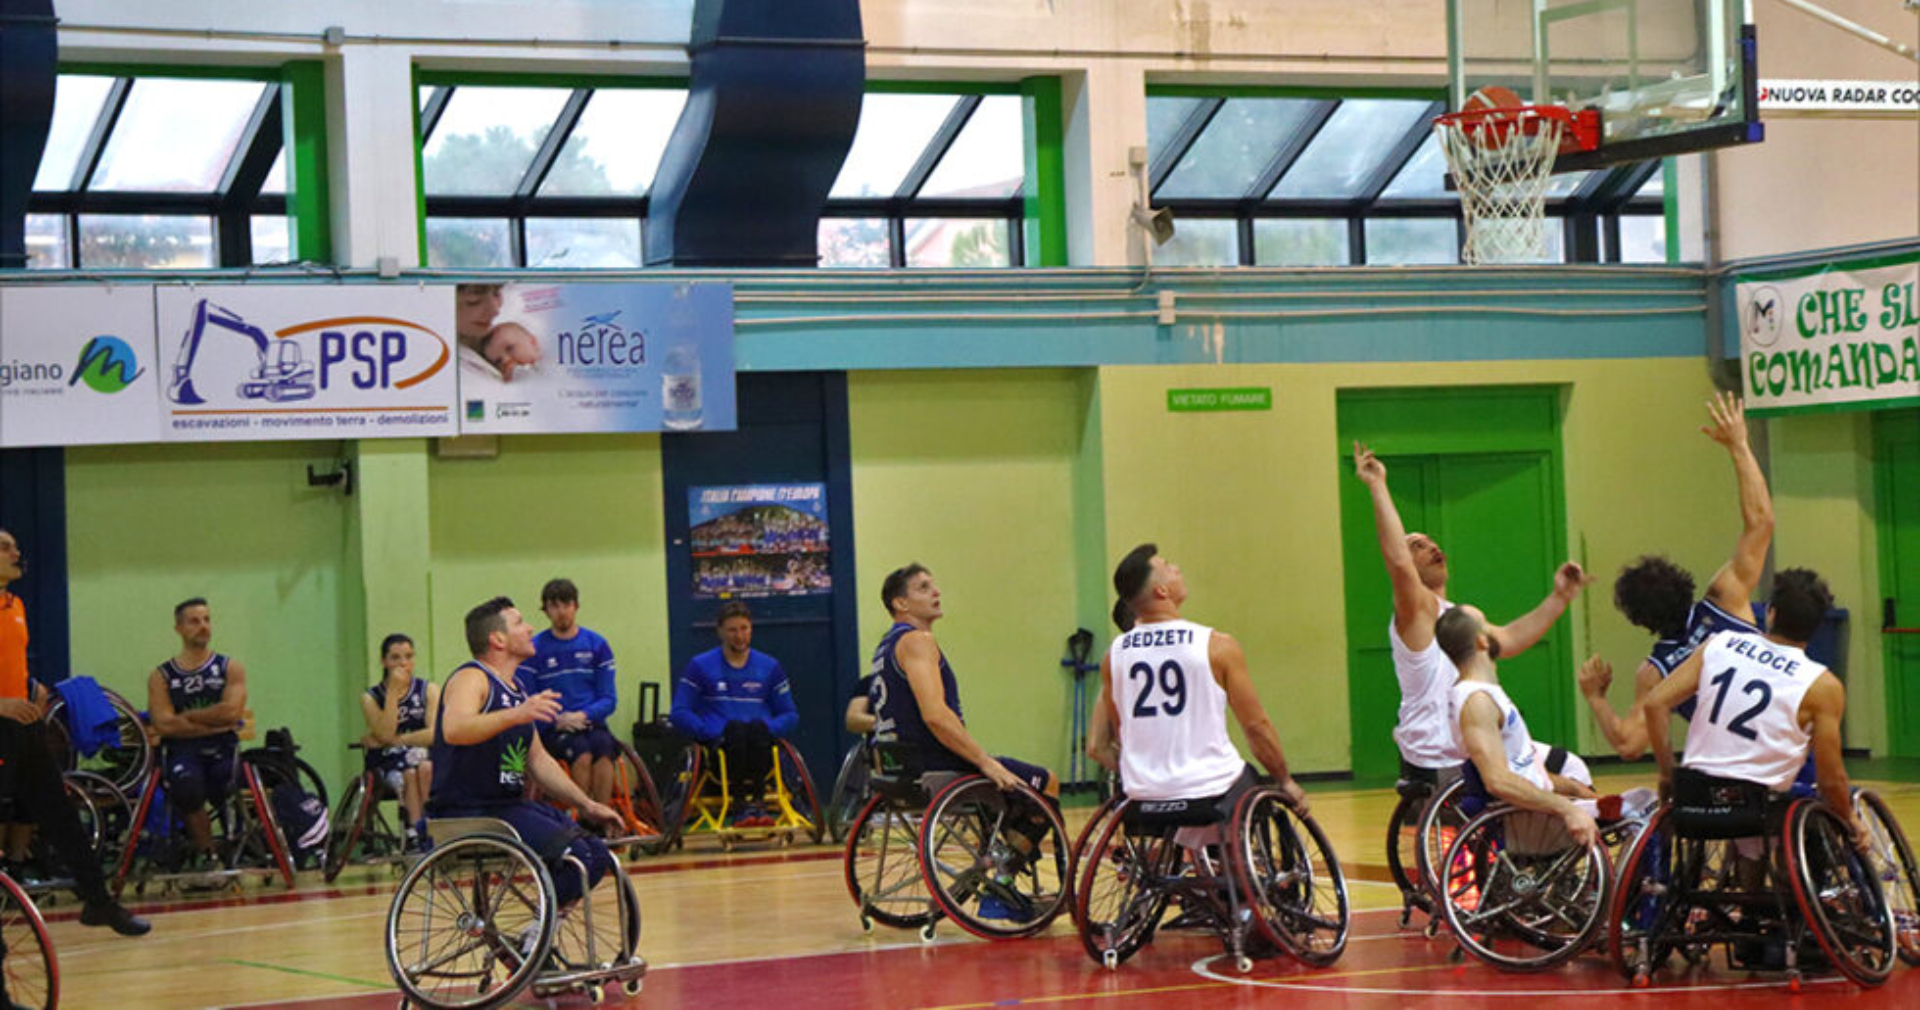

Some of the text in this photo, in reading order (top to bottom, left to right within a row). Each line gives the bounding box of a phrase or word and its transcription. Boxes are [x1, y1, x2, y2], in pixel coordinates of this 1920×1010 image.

[1768, 86, 1827, 104] NUOVA
[1832, 87, 1886, 104] RADAR
[1796, 288, 1868, 339] CHE
[0, 359, 63, 387] giano
[320, 330, 407, 390] PSP
[1750, 335, 1920, 398] COMANDA
[172, 418, 250, 428] escavazioni
[261, 416, 333, 428] movimento
[336, 416, 366, 425] terra
[377, 413, 448, 425] demolizioni
[1122, 630, 1193, 649] BEDZETI
[1725, 637, 1800, 676] VELOCE
[183, 674, 204, 693] 23
[1129, 659, 1187, 718] 29
[1708, 667, 1772, 741] 12
